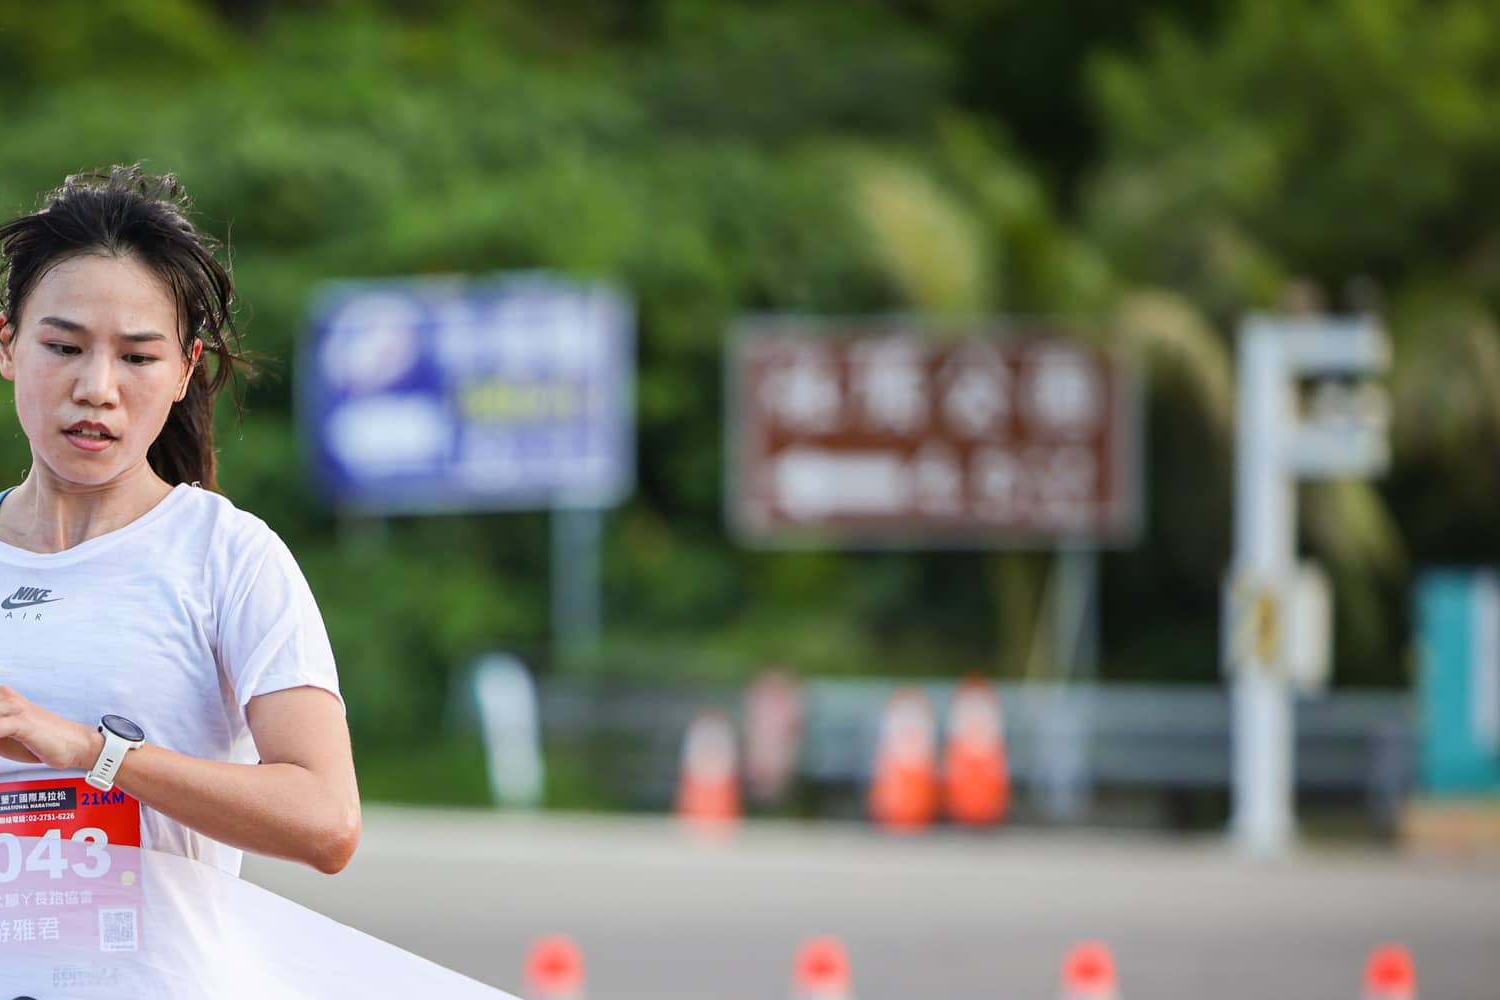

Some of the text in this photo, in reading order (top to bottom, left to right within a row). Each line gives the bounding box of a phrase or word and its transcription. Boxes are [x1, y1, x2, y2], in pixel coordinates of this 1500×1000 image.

[12, 587, 52, 601] NIKE
[5, 611, 42, 621] AIR
[81, 791, 125, 806] 21KM
